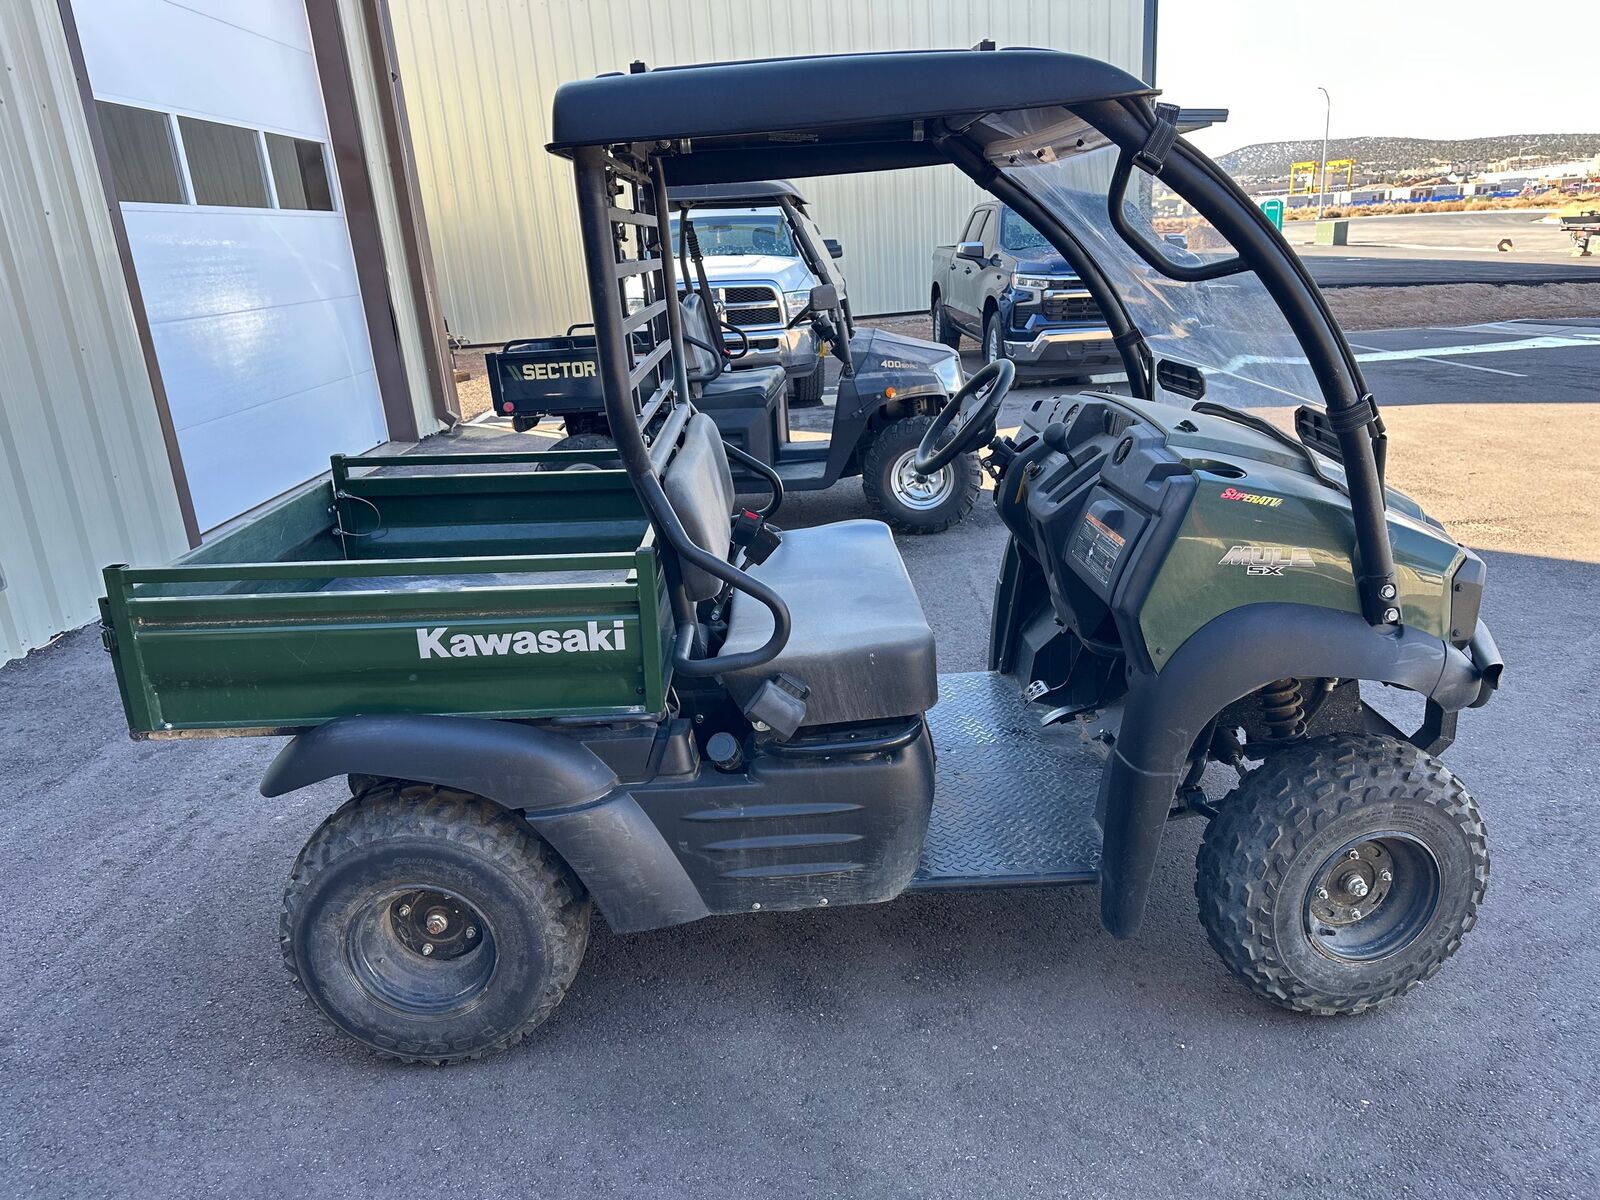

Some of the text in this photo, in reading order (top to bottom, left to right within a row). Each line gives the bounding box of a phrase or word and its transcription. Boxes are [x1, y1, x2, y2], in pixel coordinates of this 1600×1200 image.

[522, 360, 597, 381] SECTOR
[880, 359, 901, 369] 400
[1218, 545, 1316, 568] MULE
[1246, 565, 1284, 577] SX
[416, 619, 626, 660] Kawasaki
